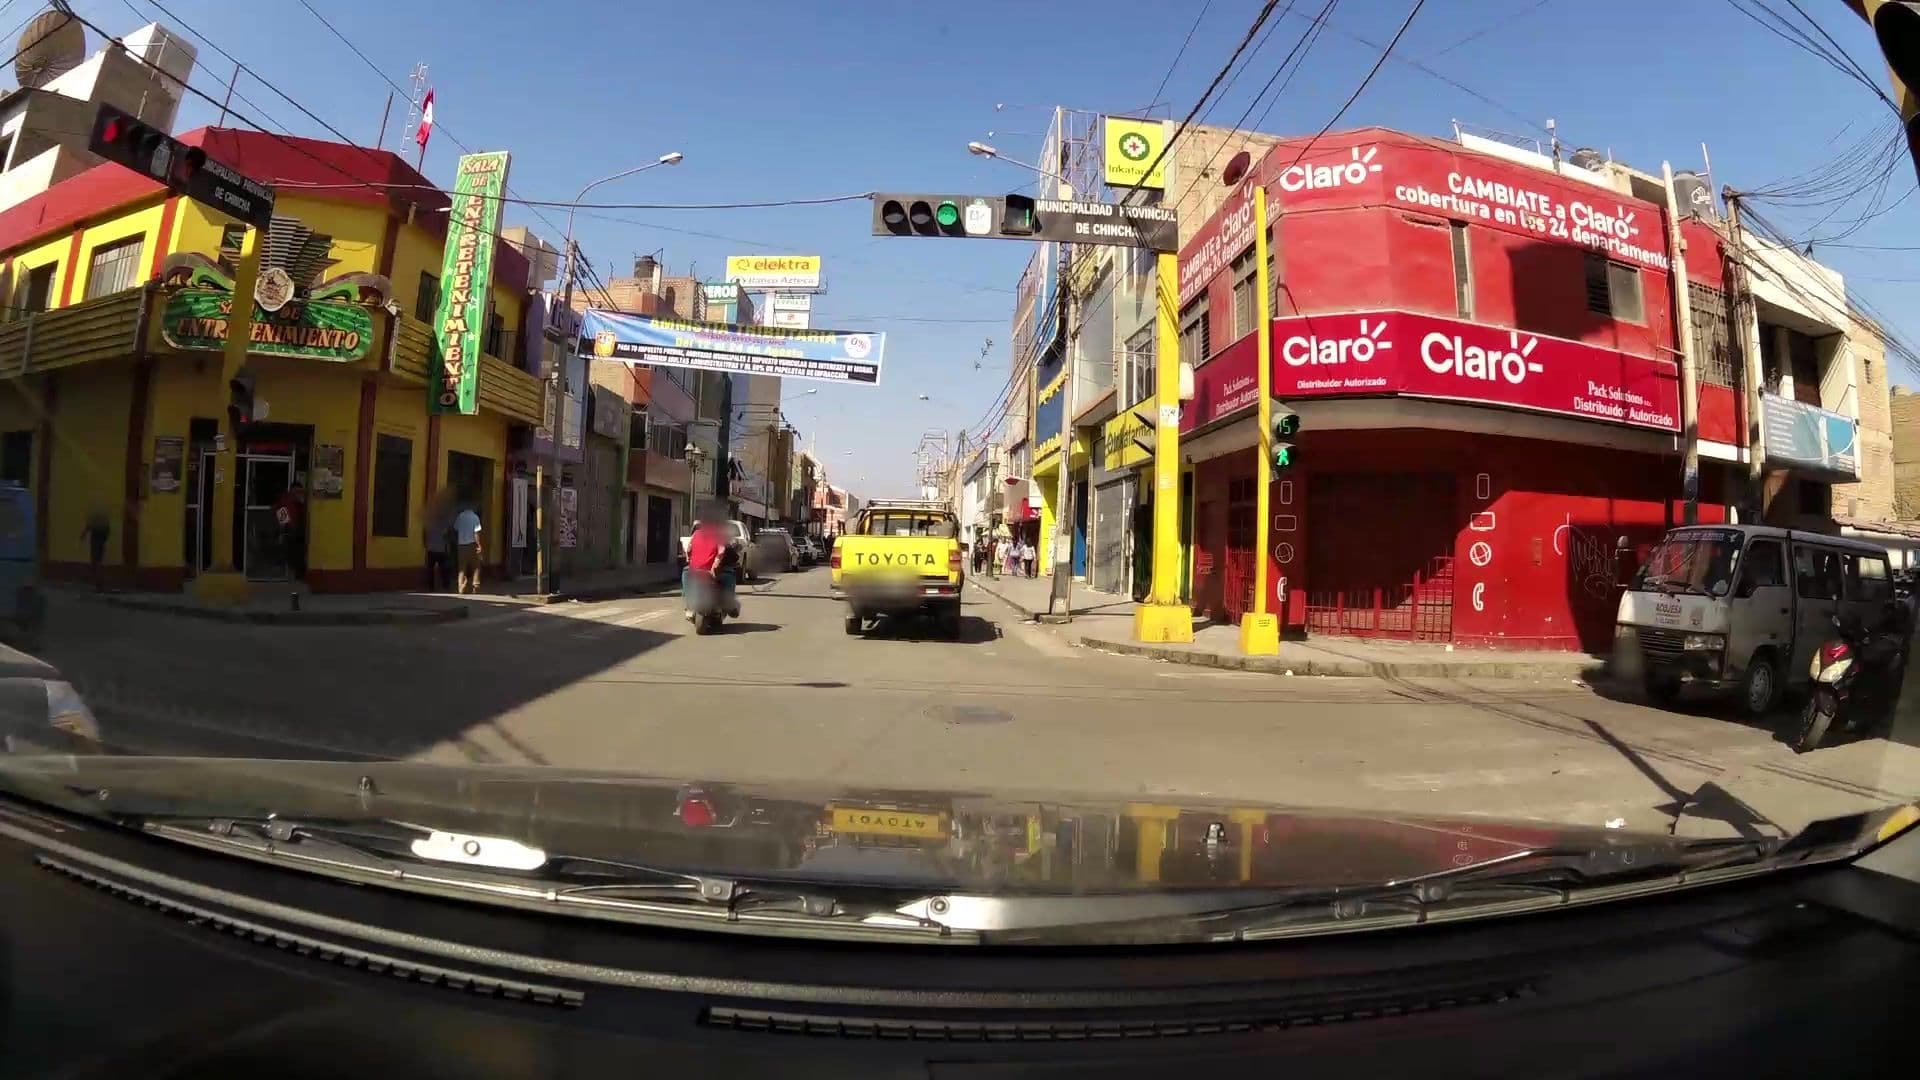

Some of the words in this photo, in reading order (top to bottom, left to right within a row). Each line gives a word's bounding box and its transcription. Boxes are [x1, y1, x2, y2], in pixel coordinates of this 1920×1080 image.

[463, 159, 499, 174] SALA
[1109, 164, 1161, 178] Inkafara
[1280, 160, 1368, 191] Claro
[472, 176, 488, 188] DE
[1036, 200, 1113, 217] MUNICIPALIDAD
[1119, 205, 1177, 222] PROVINCIAL
[1395, 184, 1491, 219] cobertura
[1494, 207, 1517, 226] en
[1519, 209, 1546, 232] los
[1549, 217, 1569, 239] 24
[1447, 172, 1552, 217] CAMBIATE
[1555, 204, 1567, 220] a
[1570, 200, 1632, 239] Claro
[1075, 222, 1090, 235] DE
[1181, 235, 1215, 284] CAMBIATE
[1221, 199, 1251, 243] Claro
[754, 258, 810, 271] elektra
[1282, 330, 1378, 366] Claro
[1420, 329, 1530, 384] Claro
[1296, 378, 1342, 389] Distribuidor
[1343, 376, 1387, 388] Autorizado
[1587, 380, 1608, 399] Pack
[1239, 387, 1259, 403] Autoriza
[1573, 396, 1628, 418] Distribuidor
[1629, 406, 1673, 426] Autorizado
[1279, 418, 1292, 435] 15
[855, 552, 936, 566] TOYOTA
